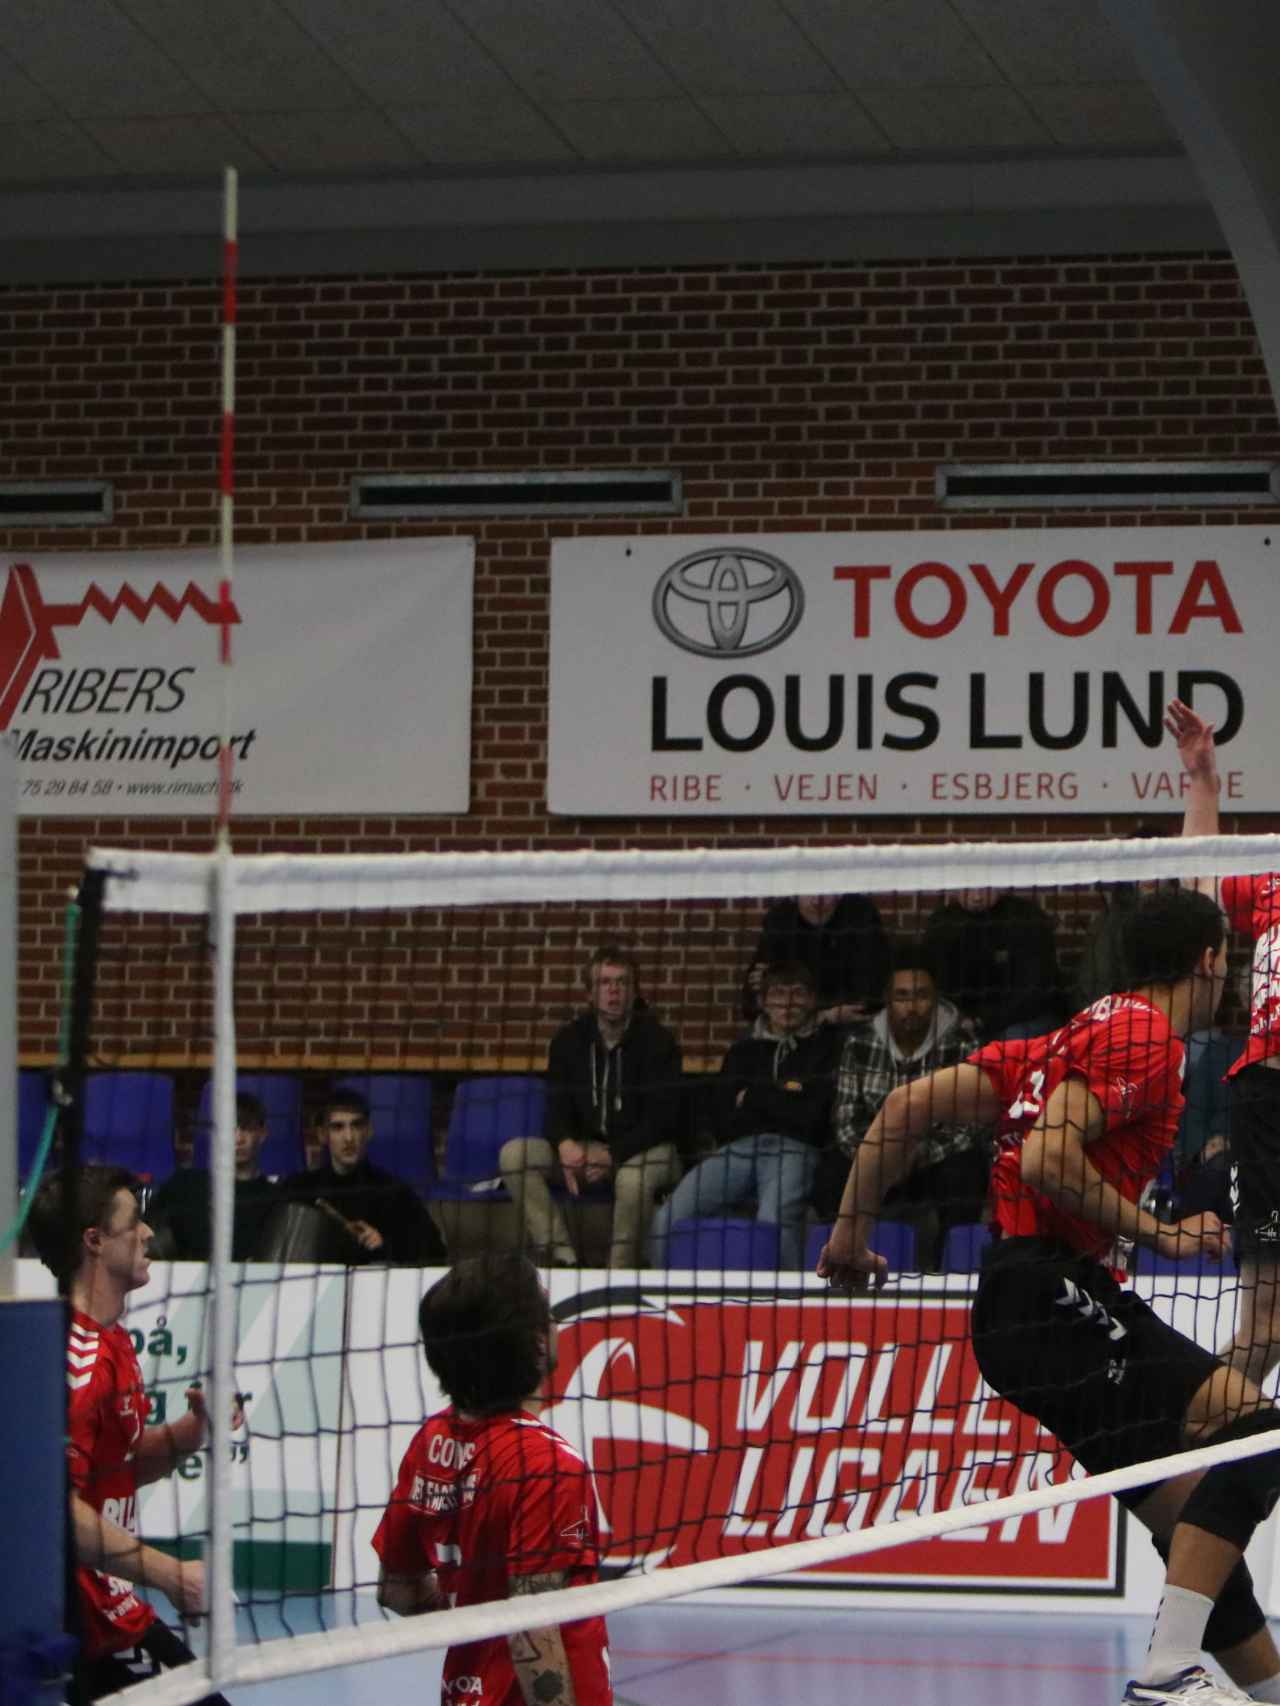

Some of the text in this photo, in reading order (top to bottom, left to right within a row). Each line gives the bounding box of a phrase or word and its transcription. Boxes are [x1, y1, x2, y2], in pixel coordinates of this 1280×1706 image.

[833, 559, 1244, 639] TOYOTA
[22, 666, 194, 713] RIBERS
[650, 670, 1245, 752] LOUIS LUND
[650, 775, 722, 802] RIBE
[773, 773, 878, 802] VEJEN
[931, 772, 1079, 801] ESBJERG
[724, 1447, 1090, 1544] LIGAEN
